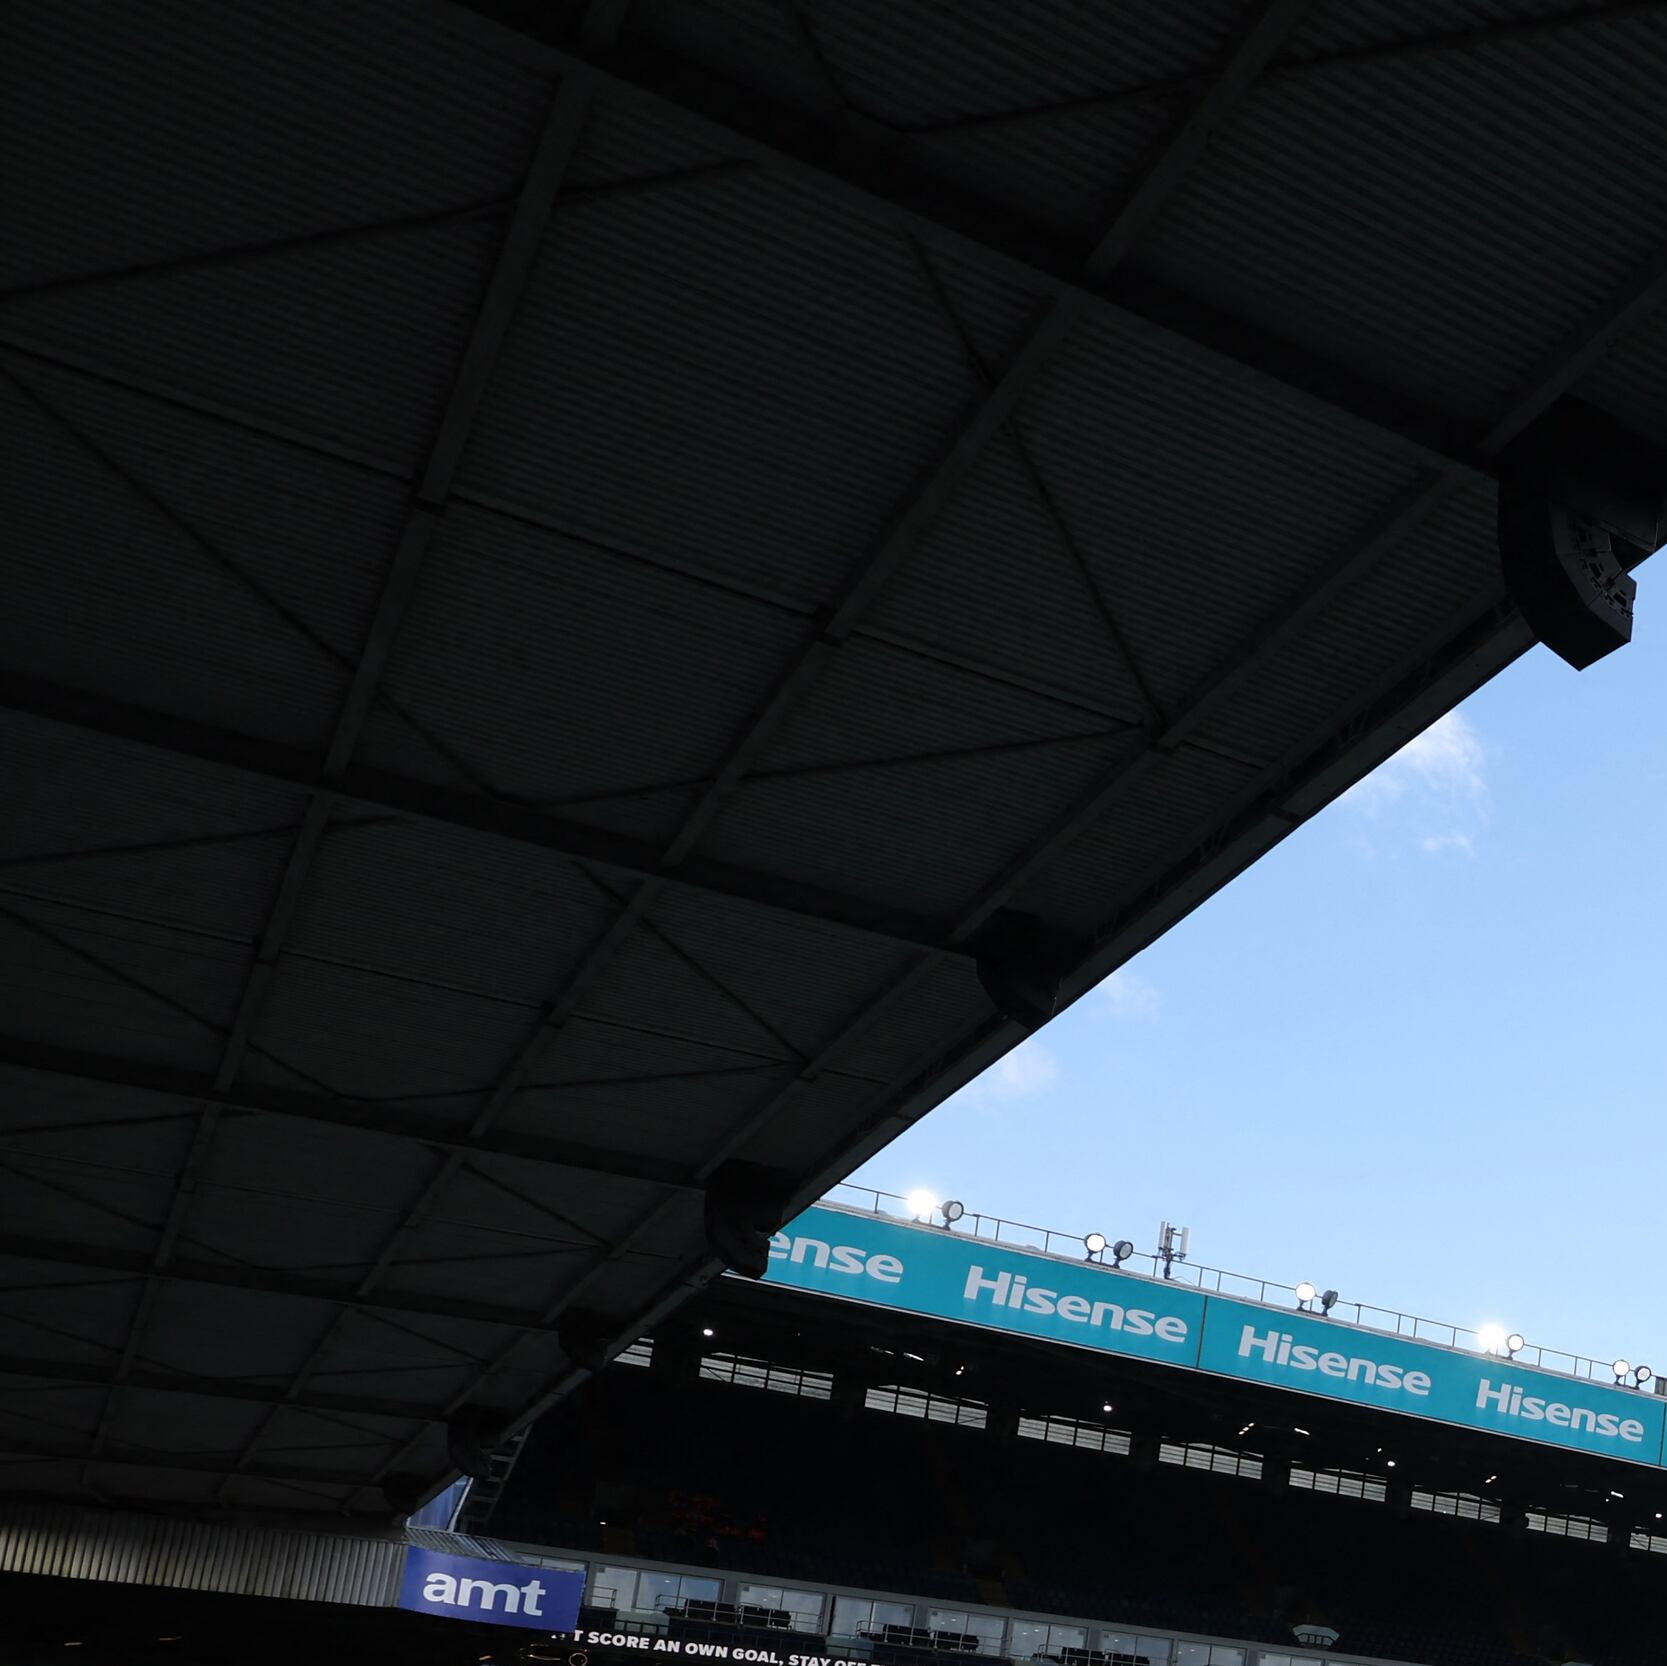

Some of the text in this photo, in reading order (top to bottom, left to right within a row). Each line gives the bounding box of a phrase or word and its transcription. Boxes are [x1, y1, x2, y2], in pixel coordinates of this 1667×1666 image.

[766, 1233, 1431, 1396] ense Hisense Hisense
[1476, 1378, 1644, 1443] Hisense
[423, 1572, 546, 1616] amt
[588, 1632, 649, 1649] SCORE
[654, 1640, 680, 1652] AN
[685, 1643, 728, 1657] OWN
[733, 1648, 783, 1666] GOAL,
